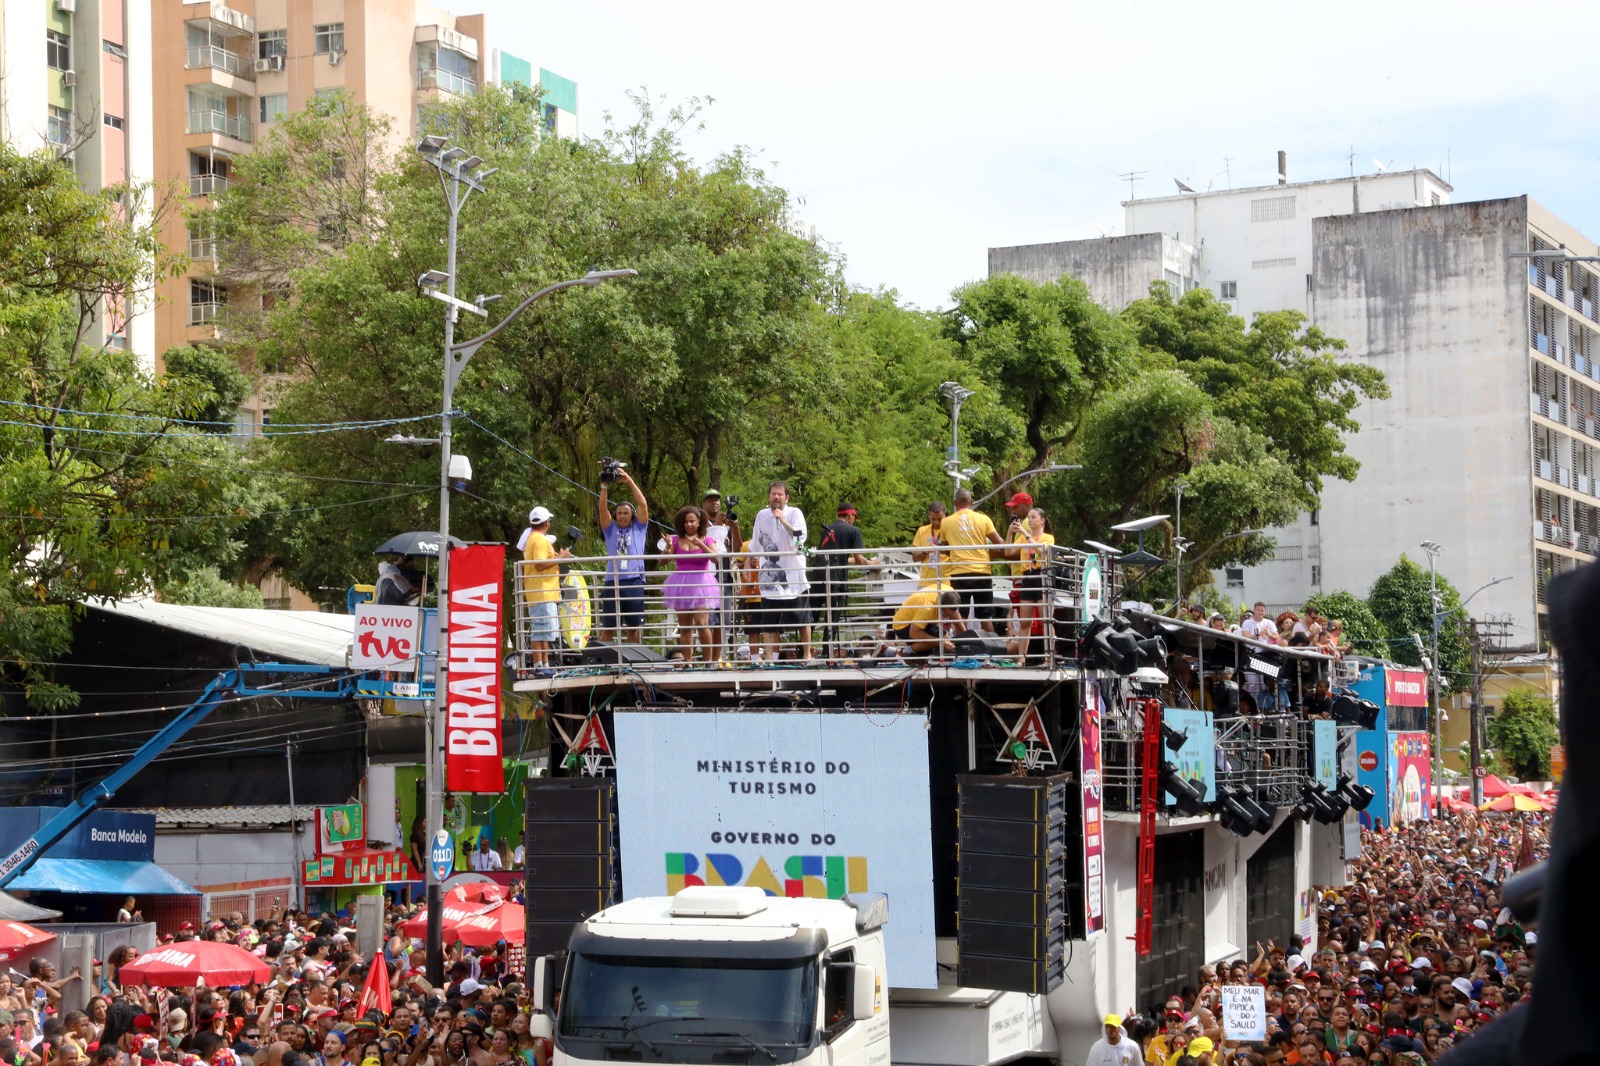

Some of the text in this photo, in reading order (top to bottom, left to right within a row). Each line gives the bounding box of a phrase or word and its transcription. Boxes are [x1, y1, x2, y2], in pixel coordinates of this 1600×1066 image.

[417, 541, 439, 551] tve
[359, 616, 413, 628] AO VIVO
[358, 631, 411, 660] tve
[448, 582, 494, 755] BRAHMA
[696, 757, 851, 775] MINISTÉRIO DO
[728, 781, 818, 795] TURISMO
[91, 827, 147, 844] Banca Modelo
[711, 830, 837, 846] GOVERNO DO
[2, 840, 38, 872] 3046-1460
[432, 848, 452, 862] 011D
[1223, 987, 1260, 996] MEU MAR
[1232, 995, 1252, 1003] É NA
[1229, 1002, 1255, 1012] PIPOCA
[1230, 1019, 1256, 1029] SAULO
